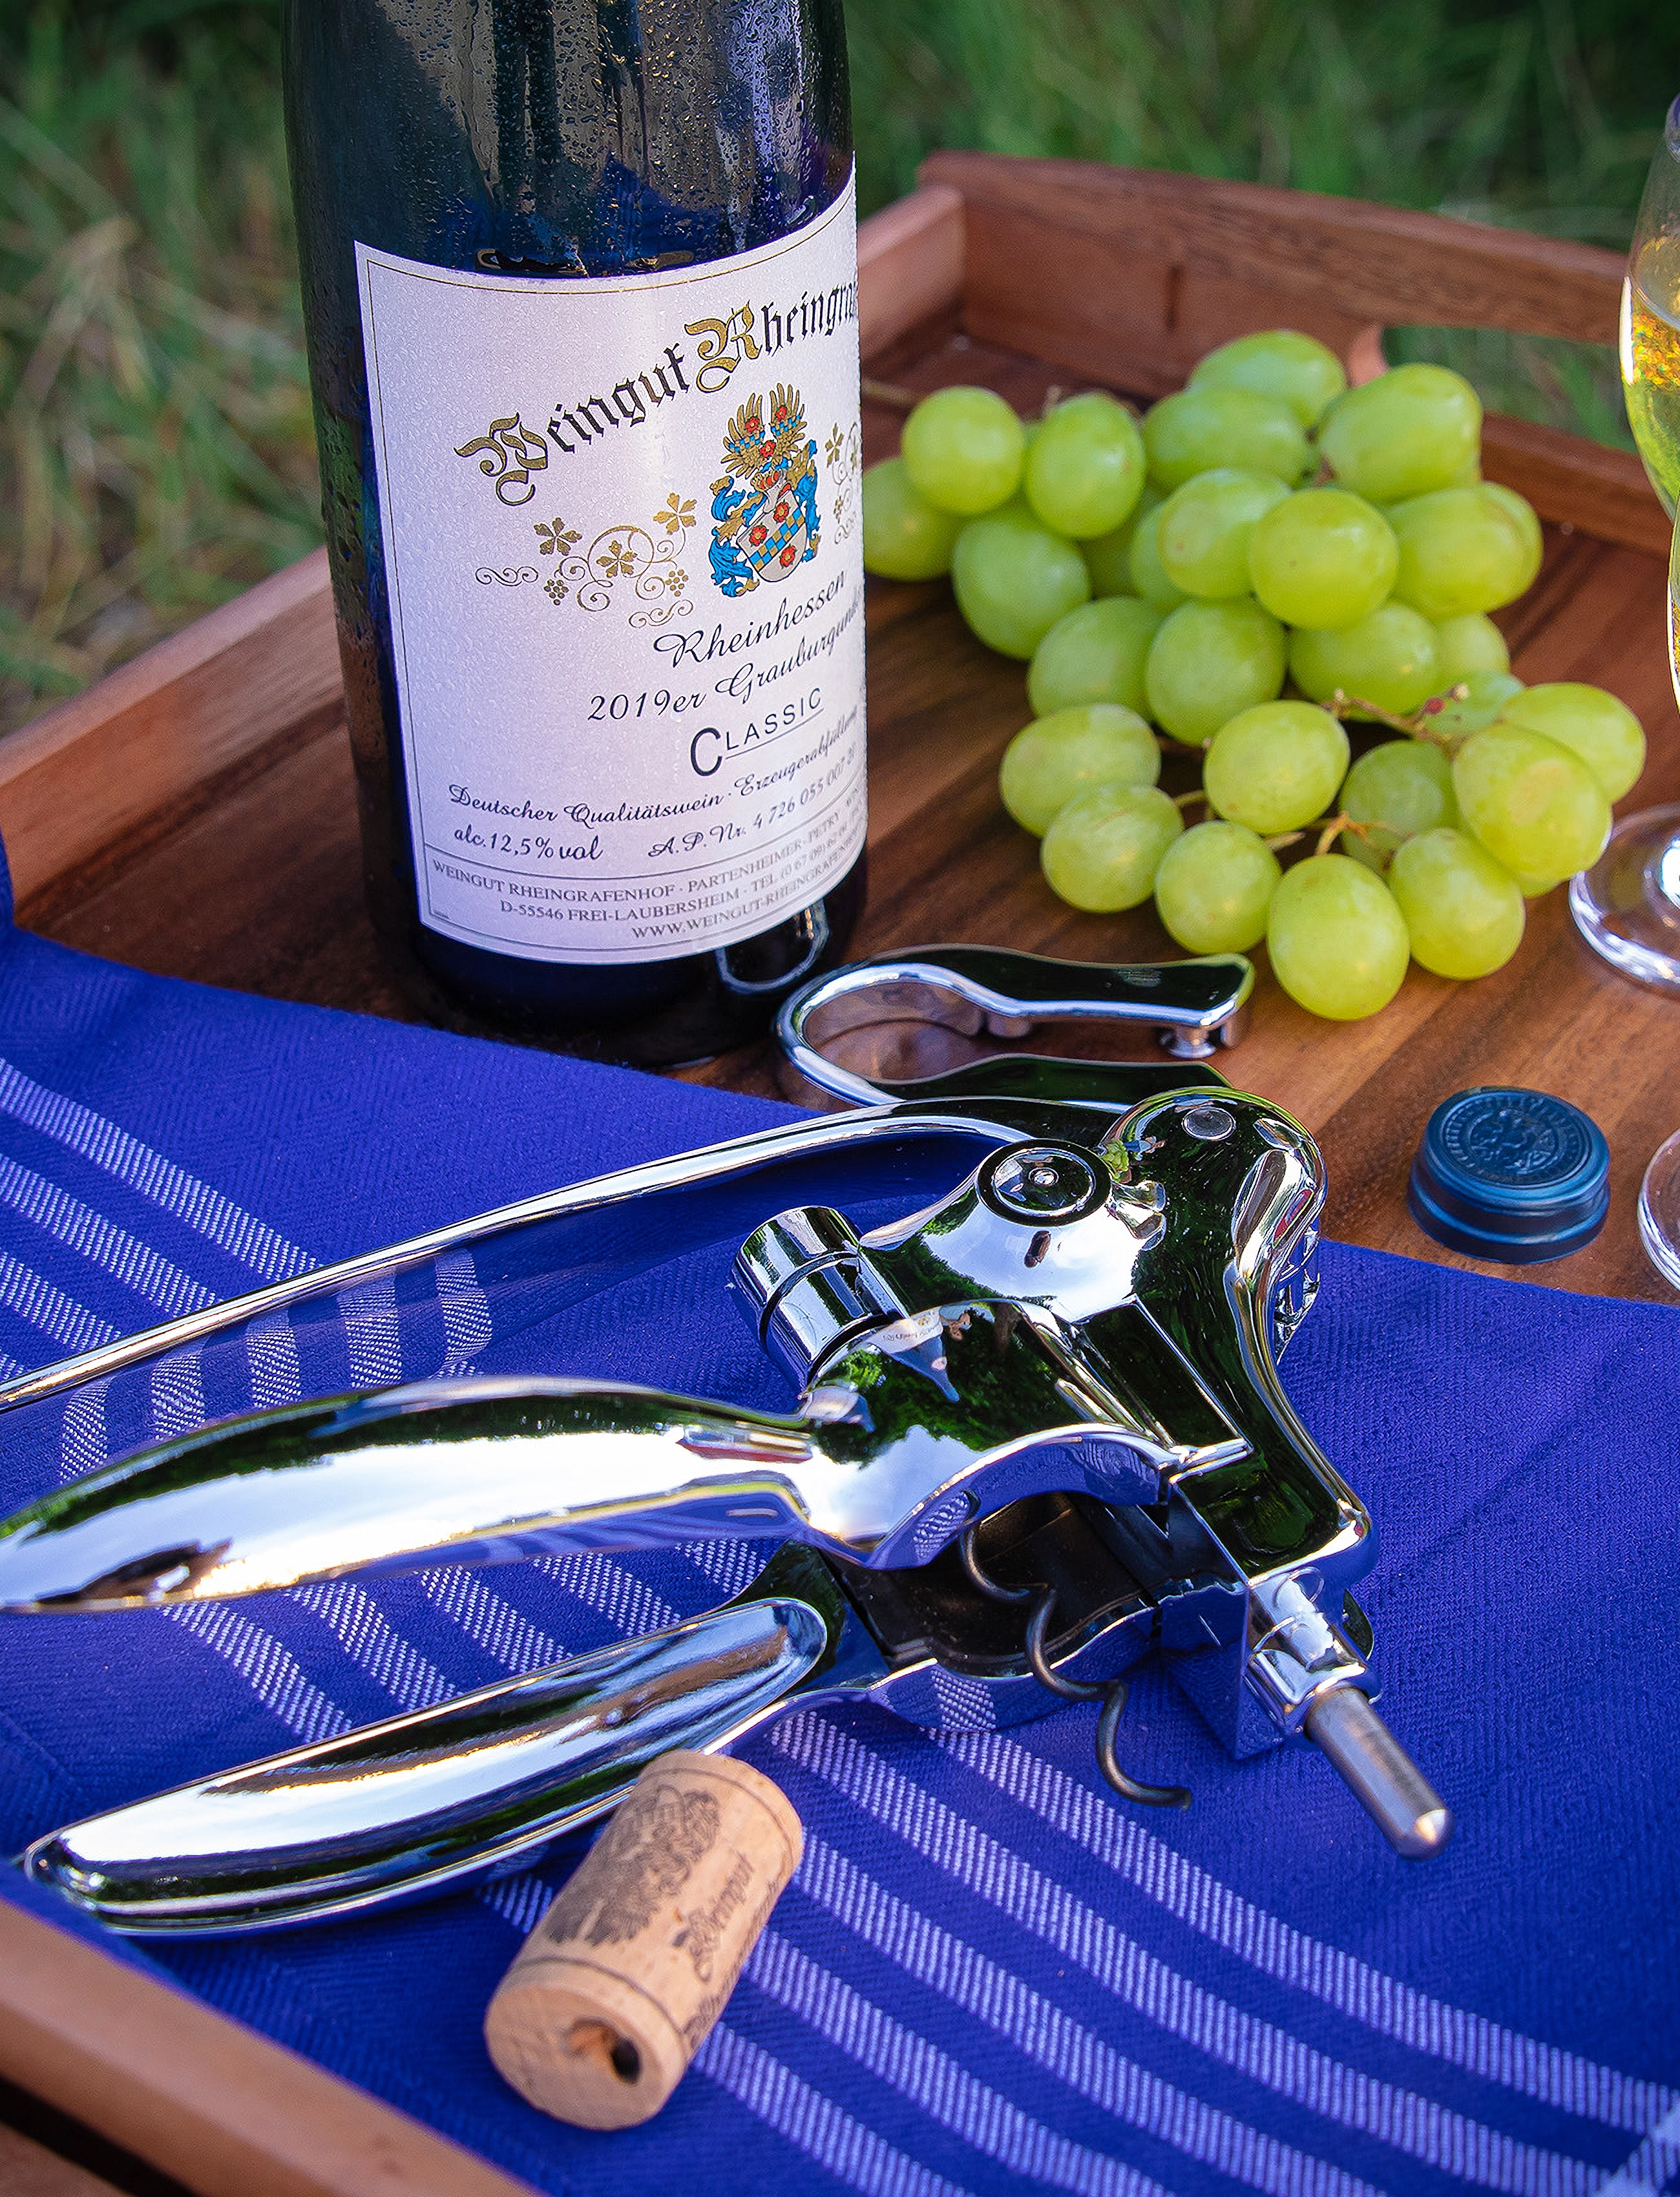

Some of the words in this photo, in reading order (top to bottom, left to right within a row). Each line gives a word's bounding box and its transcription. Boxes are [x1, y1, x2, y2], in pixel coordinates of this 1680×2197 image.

[454, 343, 690, 506] Weingut
[653, 571, 845, 668] Rheinhessen
[587, 689, 707, 721] 2019er
[449, 784, 558, 821] Deutscher
[563, 794, 724, 829] Qualitätswein
[769, 796, 795, 824] 726
[801, 778, 823, 805] 055
[433, 858, 505, 892] WEINGUT
[509, 883, 675, 903] RHEINGRAFENHOF
[688, 839, 801, 892] PARTENHEIMER
[500, 899, 563, 921] D-55546
[568, 888, 739, 921] FREI-LAUBERSHEIM
